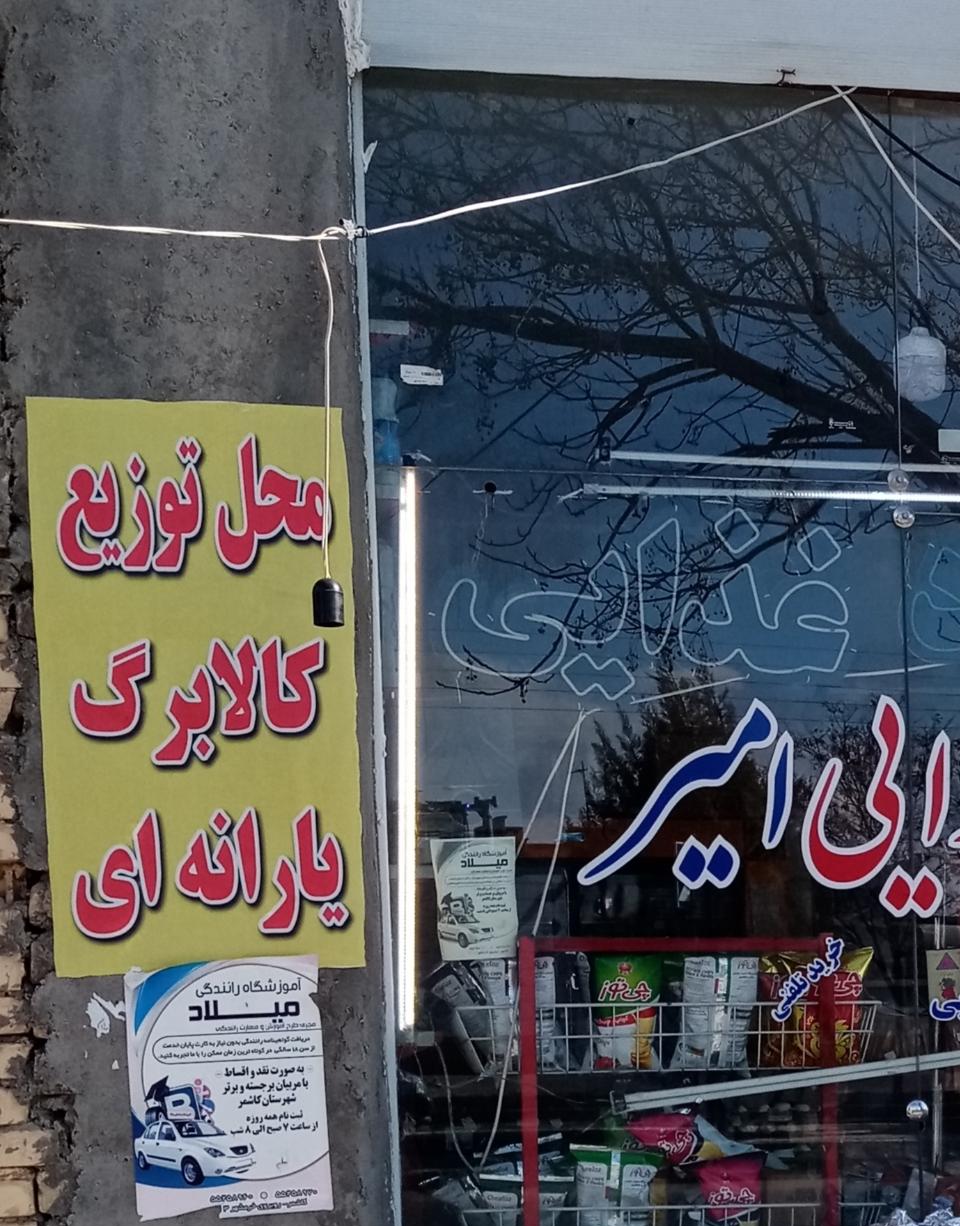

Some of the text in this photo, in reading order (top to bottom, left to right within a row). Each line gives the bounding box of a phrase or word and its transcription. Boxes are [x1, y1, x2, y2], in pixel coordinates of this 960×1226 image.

[56, 434, 332, 572] محل توزیع
[70, 635, 324, 765] کالابرگ
[578, 697, 794, 890] امیر
[460, 858, 508, 869] میلاد
[72, 805, 349, 939] یارانه ای
[771, 937, 844, 1021] خرید تلفنی
[196, 977, 301, 998] آموزشگاه رانندگی
[189, 1000, 299, 1023] میلاد
[224, 1066, 249, 1077] اقساط
[256, 1066, 269, 1074] نقد
[270, 1067, 295, 1077] صورت
[296, 1066, 304, 1075] به
[222, 1082, 238, 1094] برتر
[245, 1082, 275, 1092] برجسته
[275, 1079, 301, 1091] مربیان
[302, 1078, 308, 1089] با
[262, 1093, 296, 1106] شهرستان
[279, 1112, 288, 1121] نام
[290, 1110, 303, 1120] ثبت
[230, 1127, 244, 1136] شب
[252, 1125, 265, 1135] الی
[266, 1126, 281, 1134] صبح
[290, 1122, 310, 1131] ساعت
[311, 1121, 318, 1131] از
